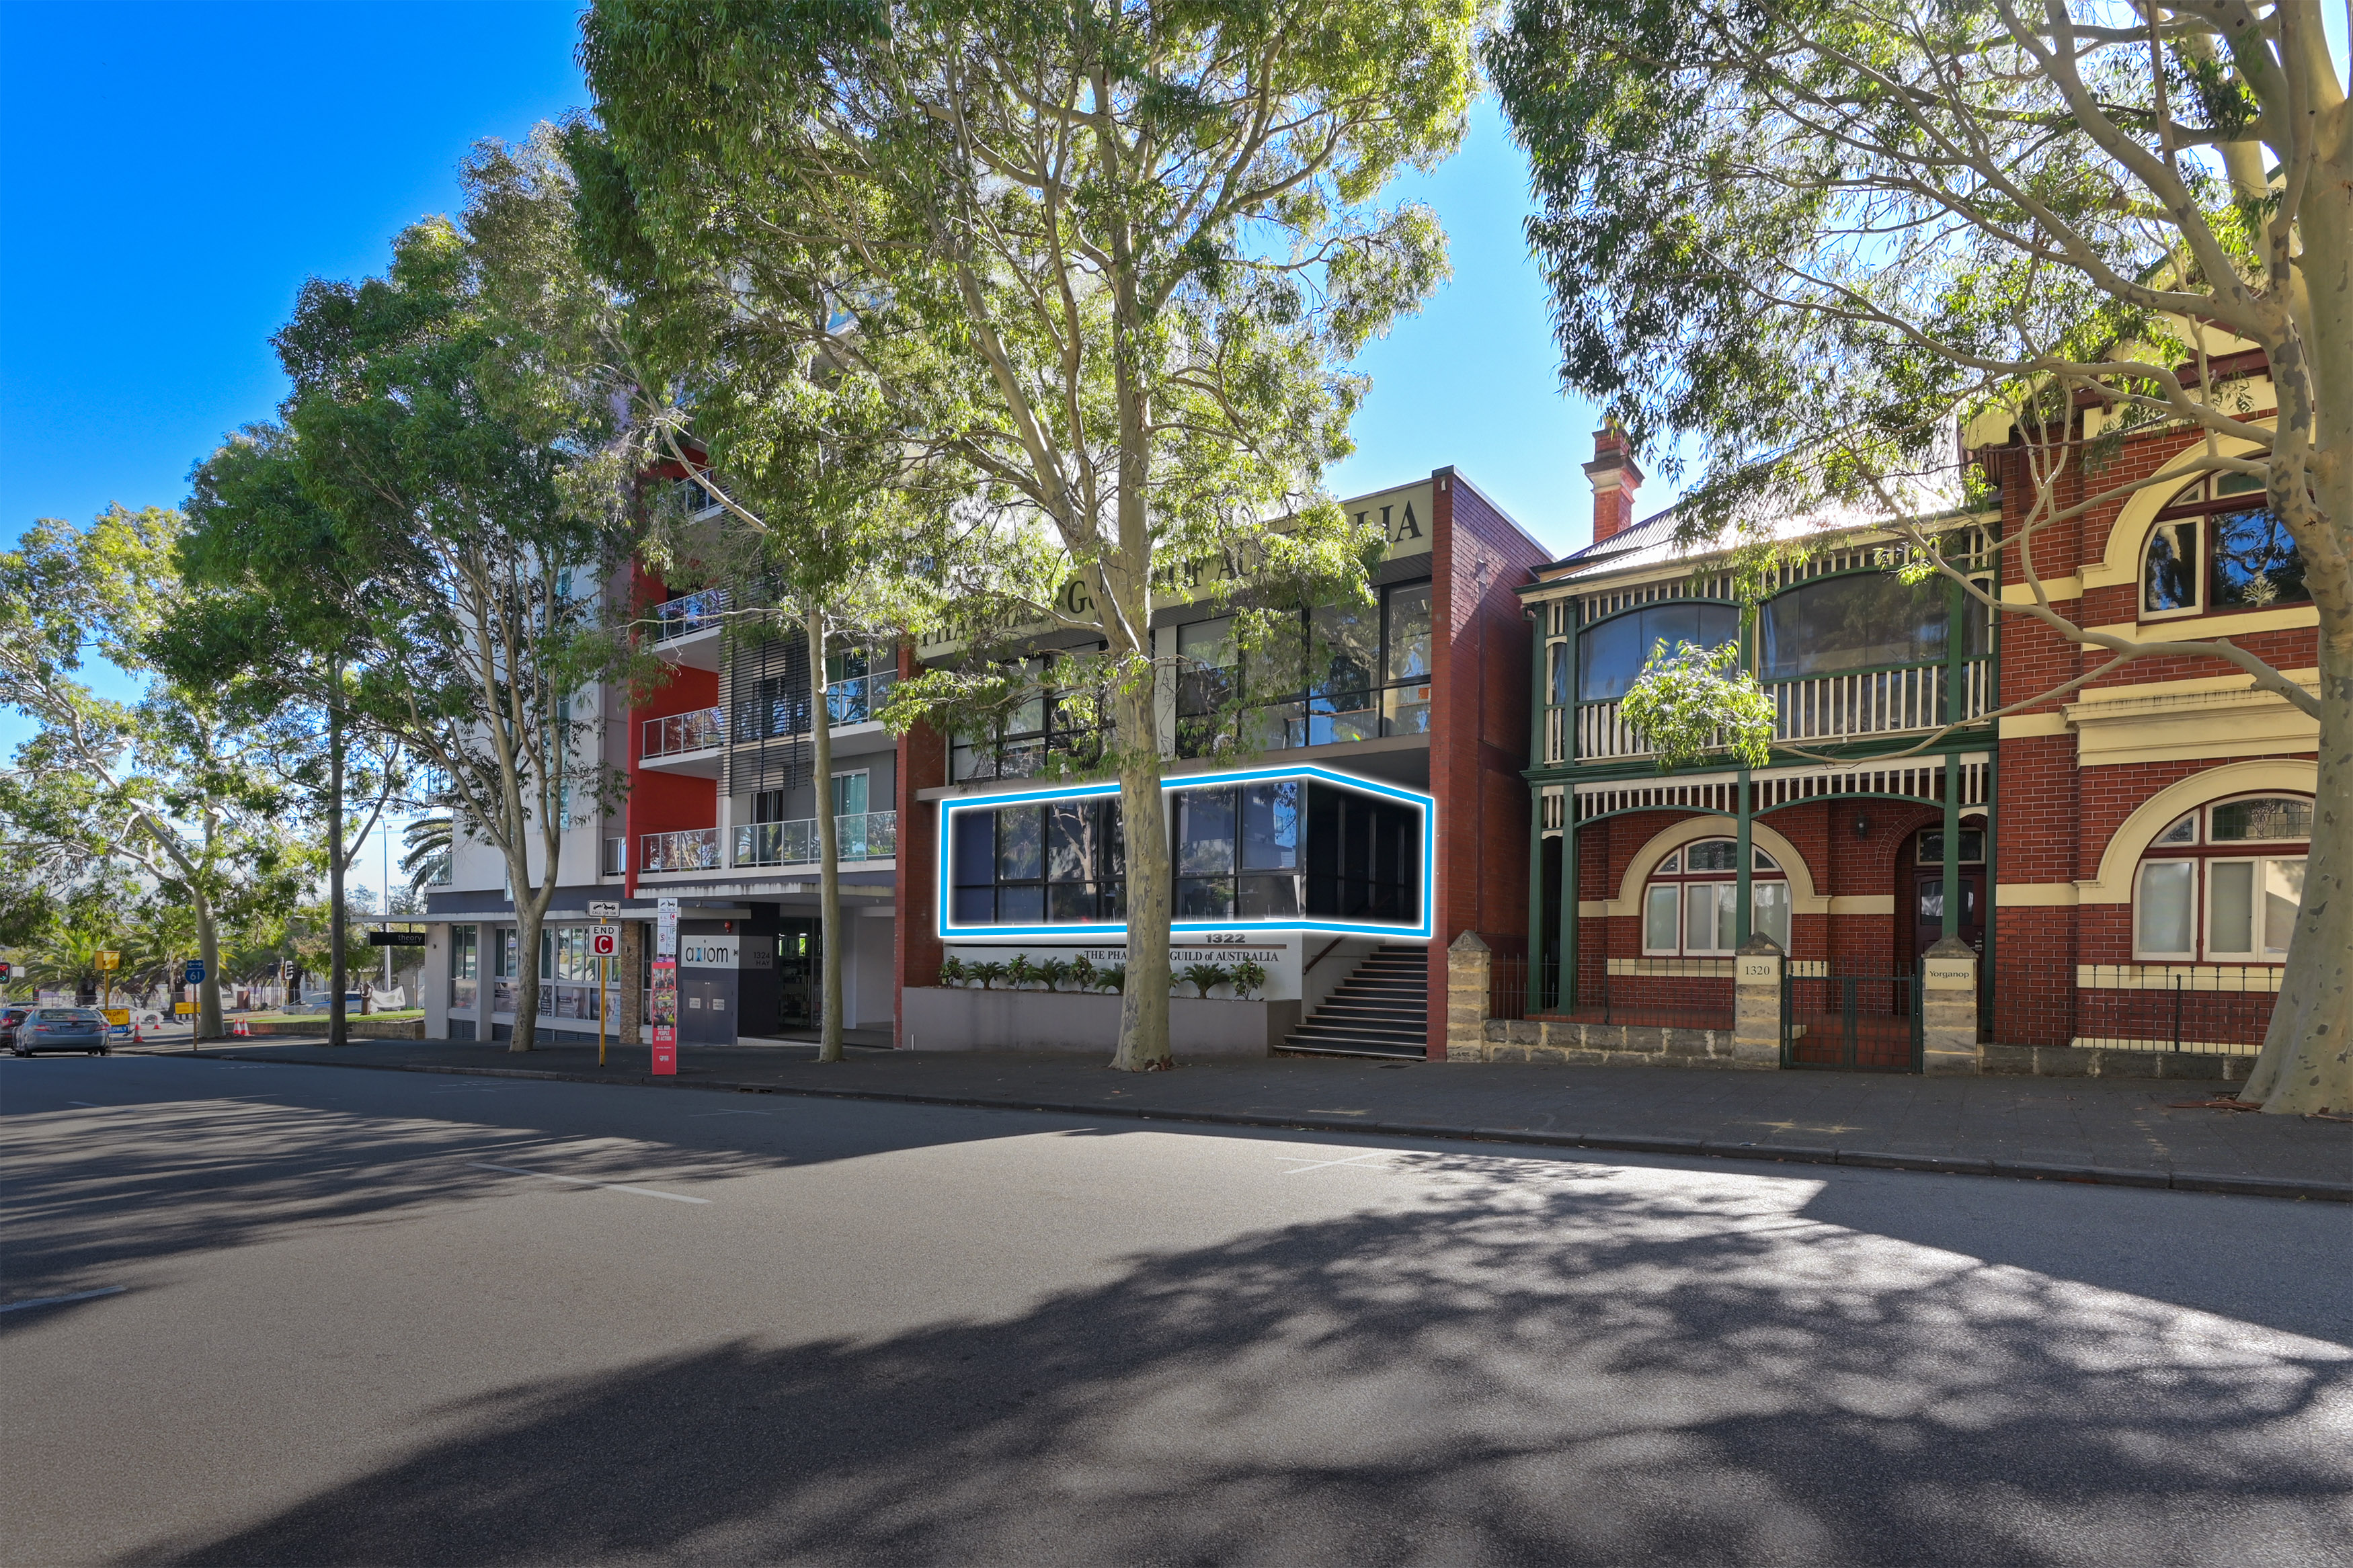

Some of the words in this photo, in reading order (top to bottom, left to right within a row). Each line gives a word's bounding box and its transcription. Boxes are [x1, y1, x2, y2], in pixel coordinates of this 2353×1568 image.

[398, 934, 422, 942] theory
[1206, 934, 1246, 944] 1322
[598, 936, 609, 952] C
[686, 940, 728, 962] axiom
[1084, 950, 1105, 960] THE
[1170, 951, 1202, 961] GUILD
[1205, 951, 1214, 961] of
[1215, 951, 1279, 962] AUSTRALIA
[1745, 965, 1770, 975] 1320
[1929, 970, 1970, 979] Yorganop
[190, 972, 200, 981] 61
